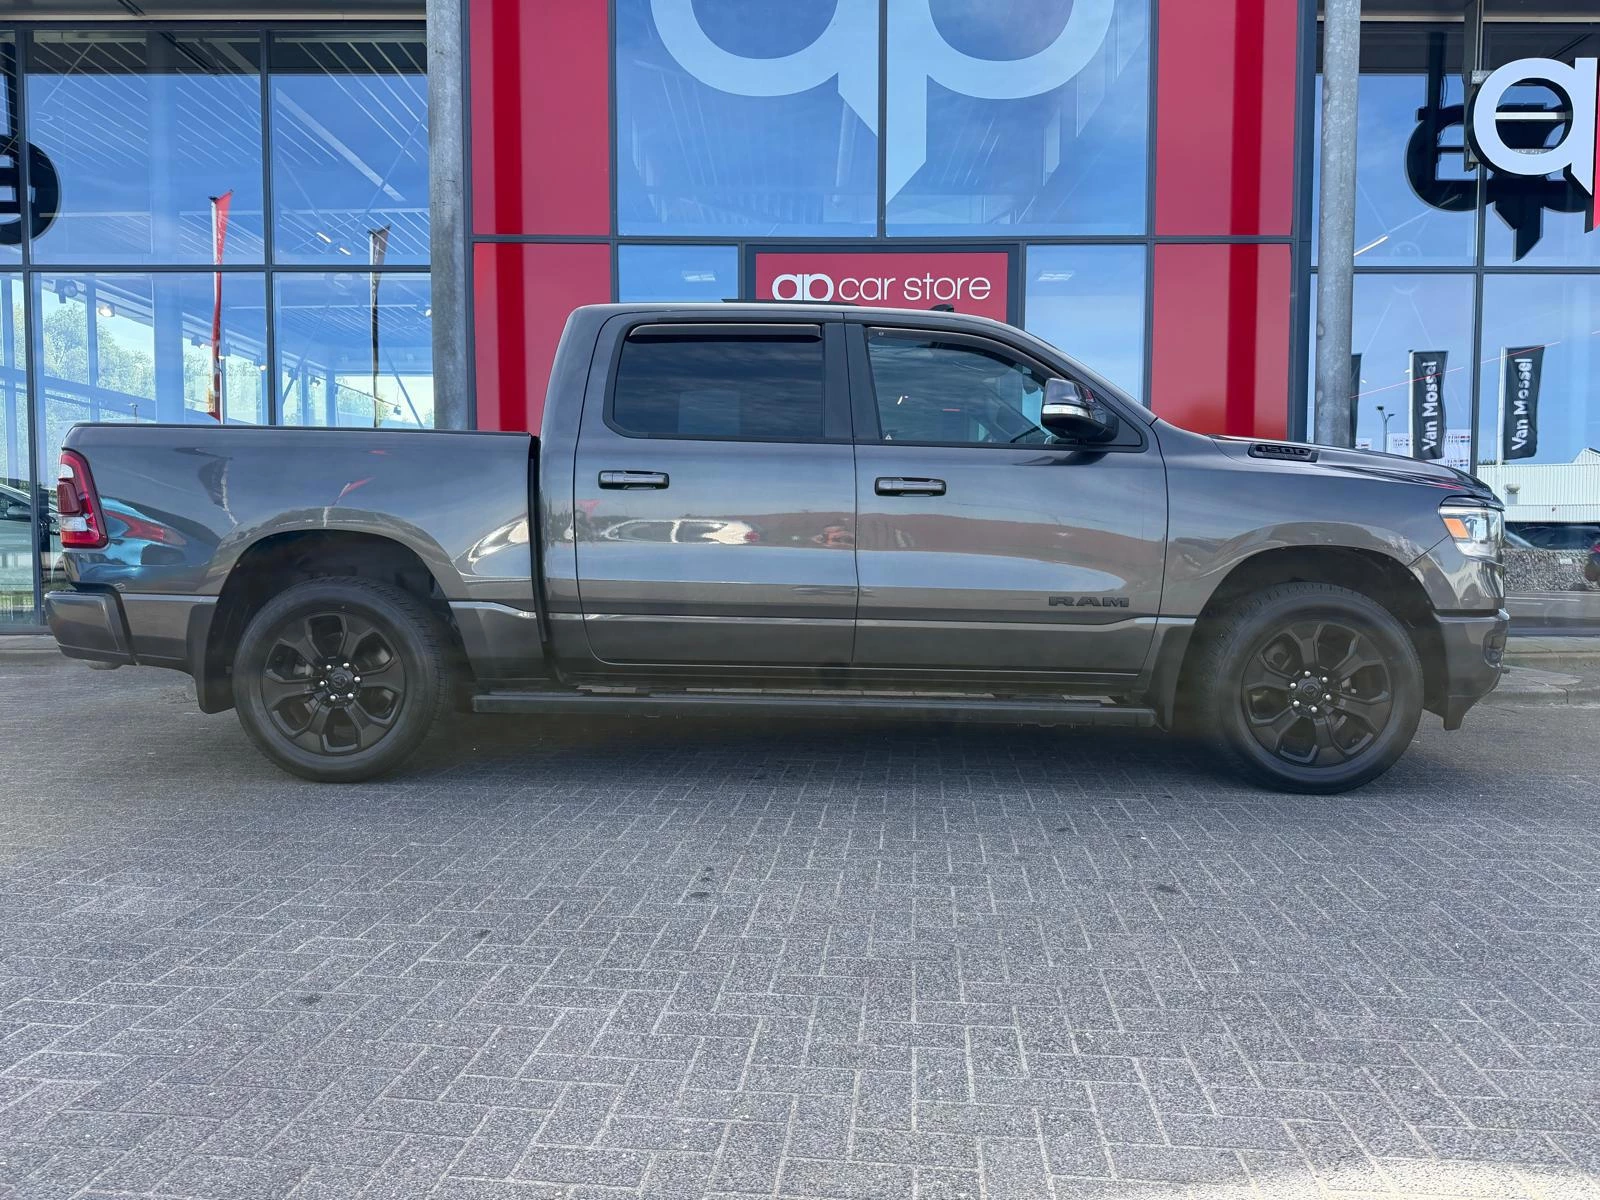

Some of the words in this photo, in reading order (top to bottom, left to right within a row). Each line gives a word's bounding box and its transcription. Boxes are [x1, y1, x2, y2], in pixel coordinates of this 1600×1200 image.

[1472, 57, 1600, 196] a
[838, 277, 897, 301] car
[903, 272, 991, 301] store
[1422, 360, 1438, 417] Mossel
[1513, 358, 1533, 416] Mossel
[1421, 420, 1438, 451] Van
[1511, 419, 1529, 451] Van
[1048, 596, 1130, 608] RAM
